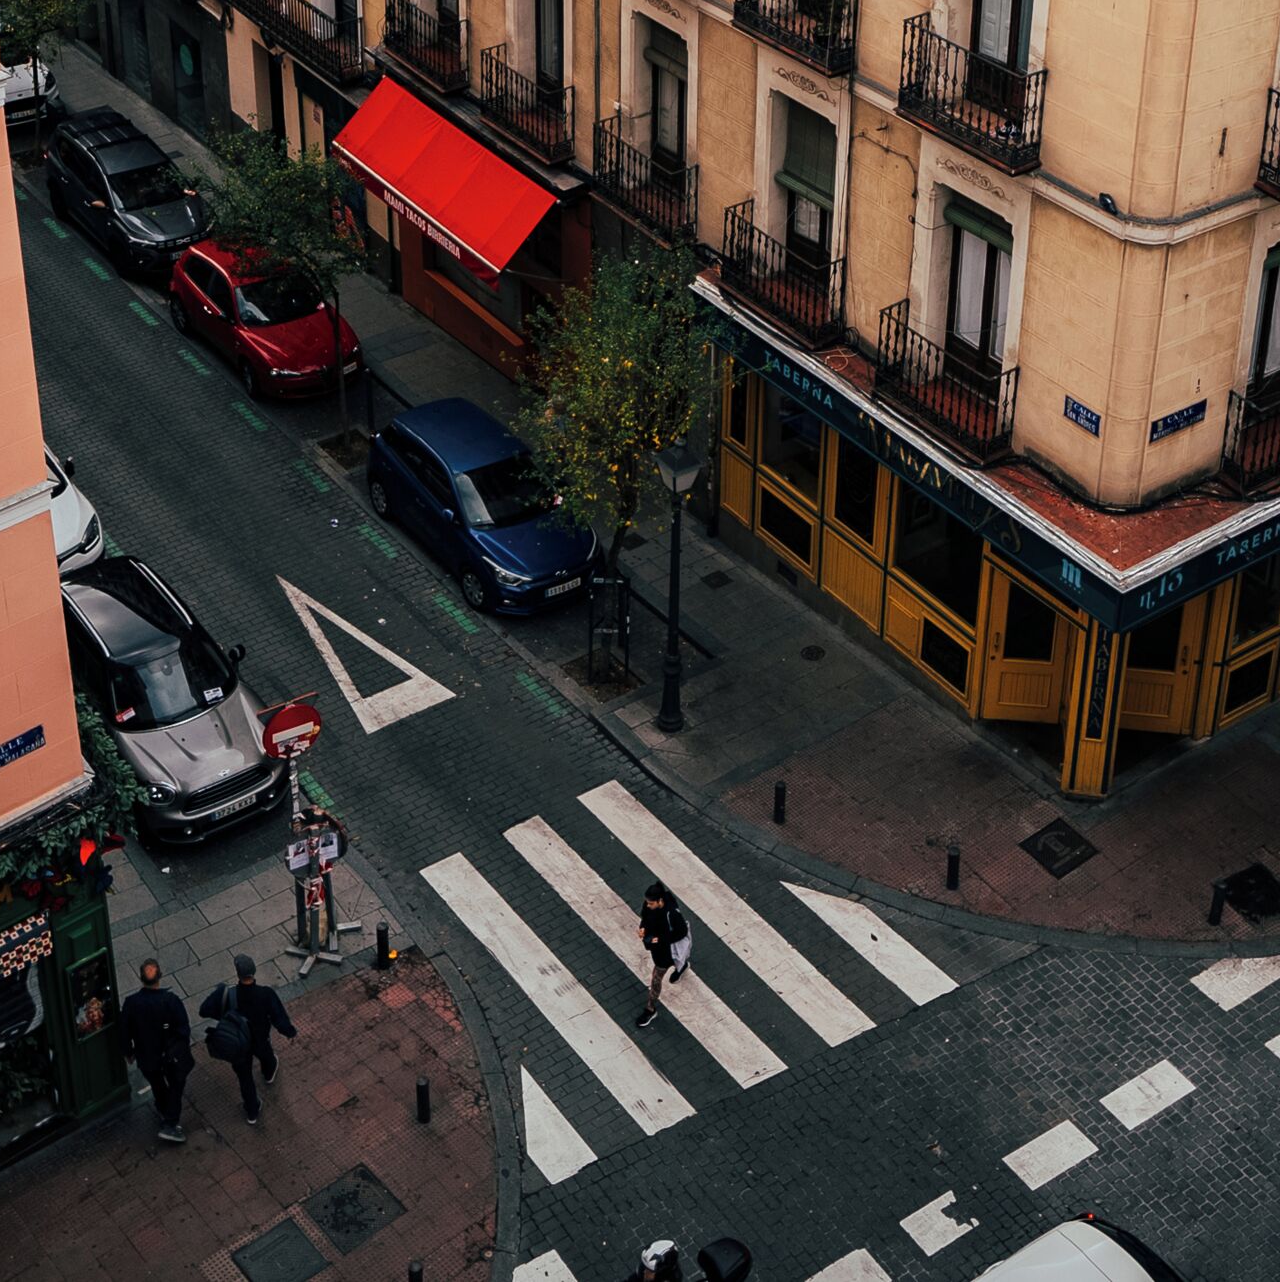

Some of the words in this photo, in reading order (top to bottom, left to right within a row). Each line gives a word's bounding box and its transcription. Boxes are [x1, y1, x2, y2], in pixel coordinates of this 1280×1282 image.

[384, 189, 404, 215] MAMI
[405, 205, 426, 232] TACOS
[765, 350, 832, 410] TABERNA
[1073, 401, 1097, 422] CALLE
[1167, 408, 1195, 424] CALLE
